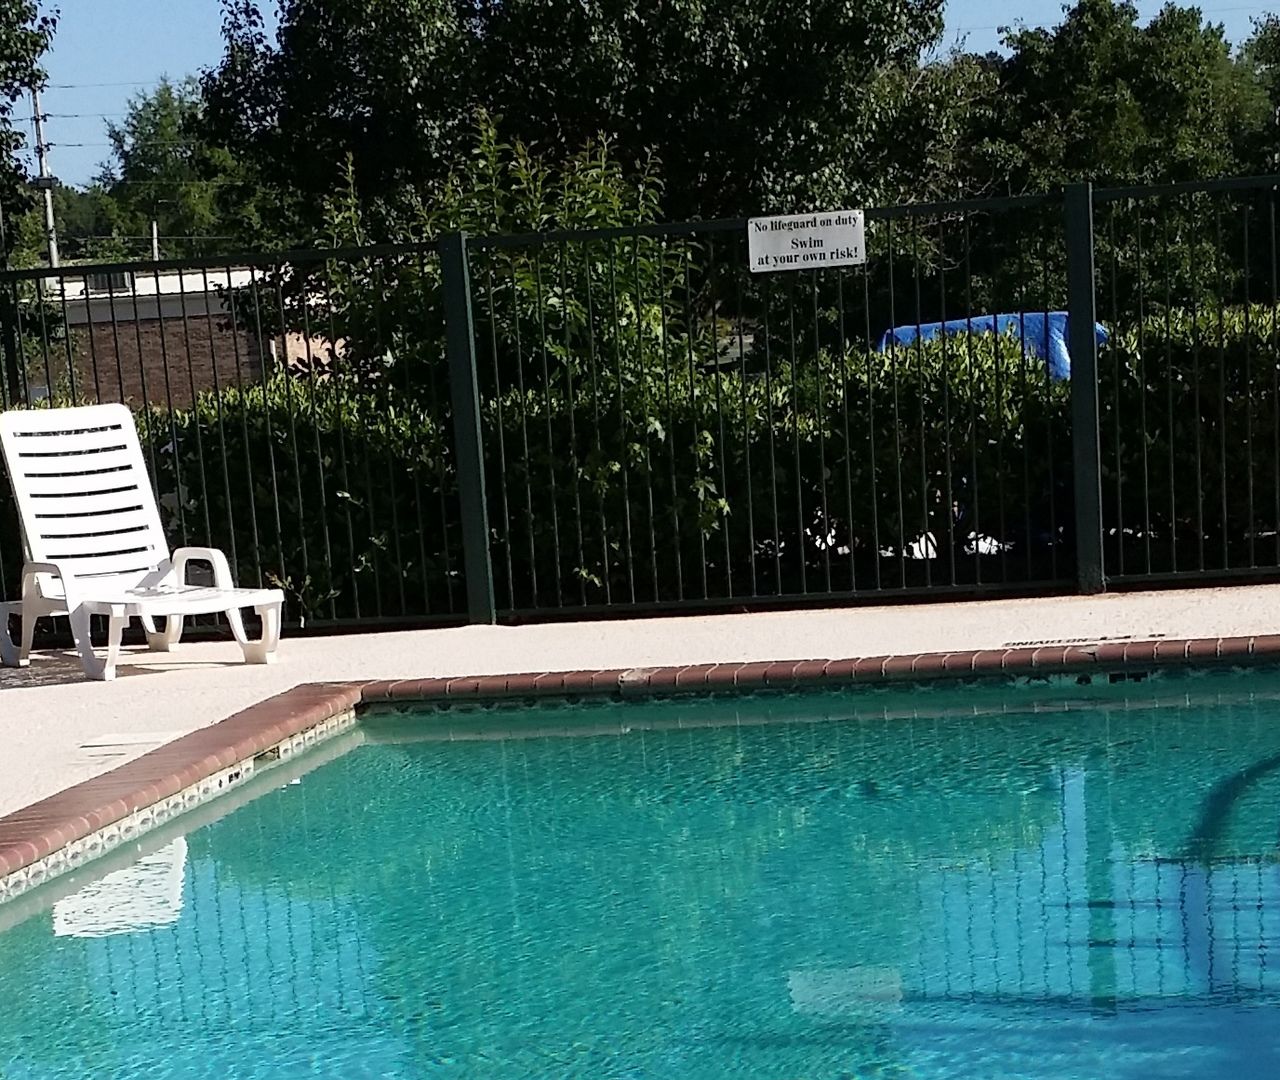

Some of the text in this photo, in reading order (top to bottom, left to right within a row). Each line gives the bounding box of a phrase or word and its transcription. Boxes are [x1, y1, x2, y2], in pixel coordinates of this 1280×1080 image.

[754, 222, 768, 232] No
[770, 217, 816, 231] lifeguard
[836, 216, 858, 227] duty
[791, 237, 824, 249] Swim
[758, 247, 858, 267] at your own risk!
